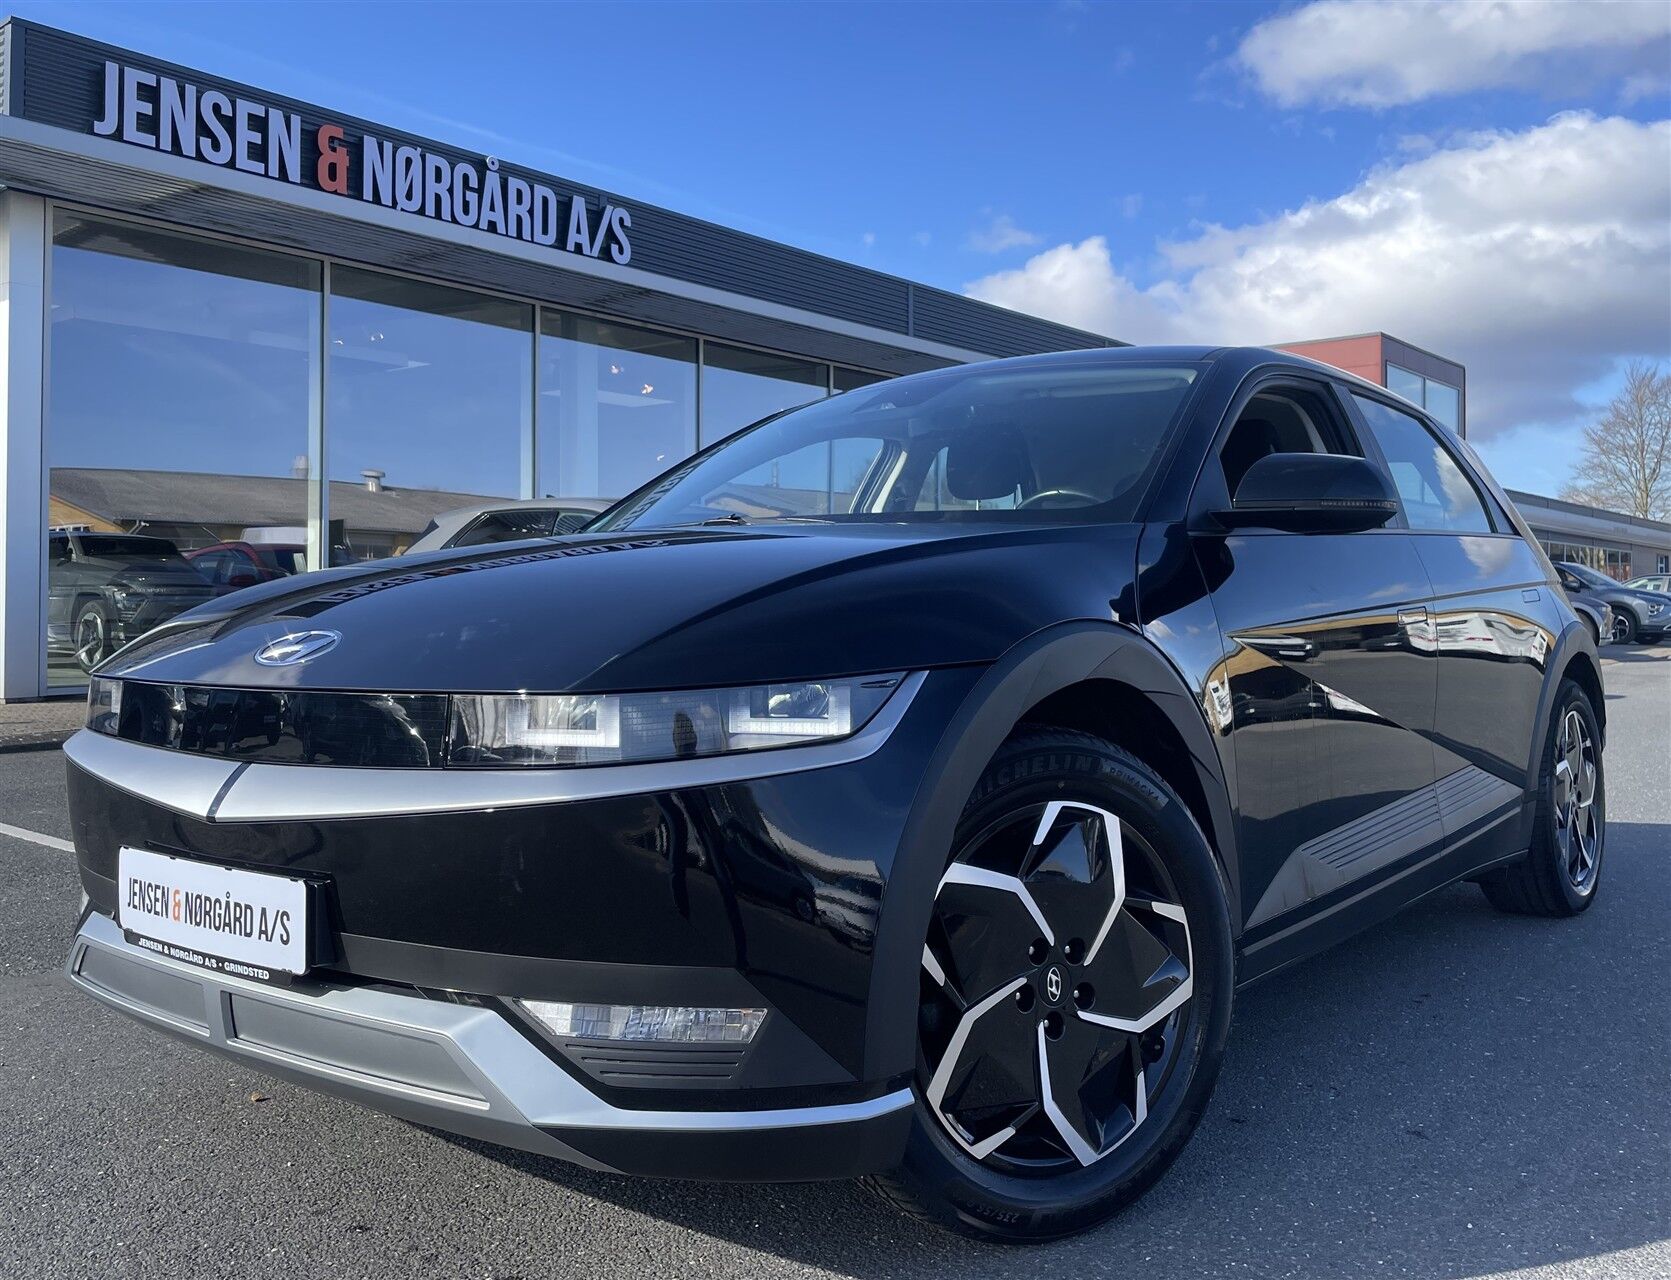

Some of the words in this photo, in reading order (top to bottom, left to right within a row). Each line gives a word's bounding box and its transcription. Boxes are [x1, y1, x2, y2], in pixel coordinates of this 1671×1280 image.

[94, 60, 300, 184] JENSEN
[317, 125, 349, 195] &
[362, 135, 557, 247] NØRGÅRD
[566, 195, 632, 265] A/S
[128, 877, 169, 918] JENSEN
[173, 889, 181, 921] &
[185, 891, 254, 938] NØRGÅRD
[258, 907, 290, 945] A/S
[139, 937, 163, 952] JENSEN
[163, 945, 169, 954] &
[170, 947, 203, 965] NØRGÅRD
[204, 957, 217, 968] A/S
[224, 962, 270, 980] GRINDSTED
